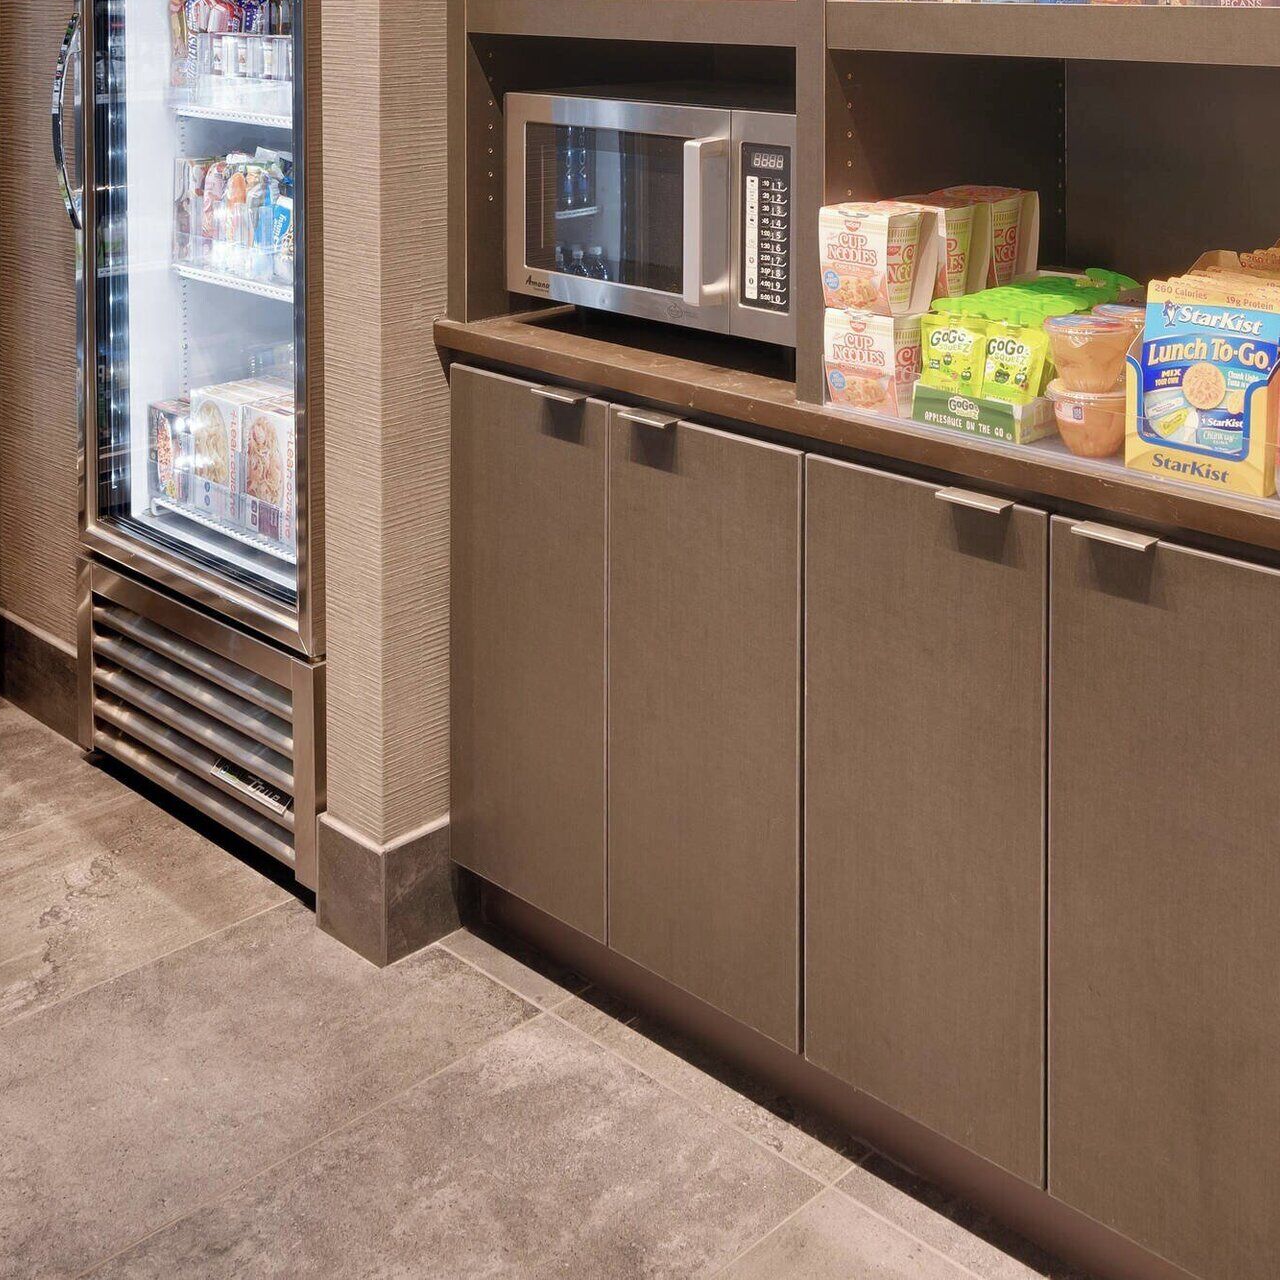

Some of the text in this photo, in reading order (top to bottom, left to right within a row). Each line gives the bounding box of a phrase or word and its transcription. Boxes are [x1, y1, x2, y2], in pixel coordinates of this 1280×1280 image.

[838, 233, 868, 248] CUP
[827, 245, 878, 266] NOODLES
[1153, 283, 1274, 311] 260 Calories 19g Protein
[1178, 305, 1263, 337] StarKist
[844, 333, 874, 348] CUP
[1147, 338, 1208, 367] Lunch
[833, 345, 885, 367] NOODLES
[1161, 367, 1182, 378] MIX
[924, 411, 1005, 438] APPLESAUCE ON THE GO
[1152, 453, 1230, 483] StarKist
